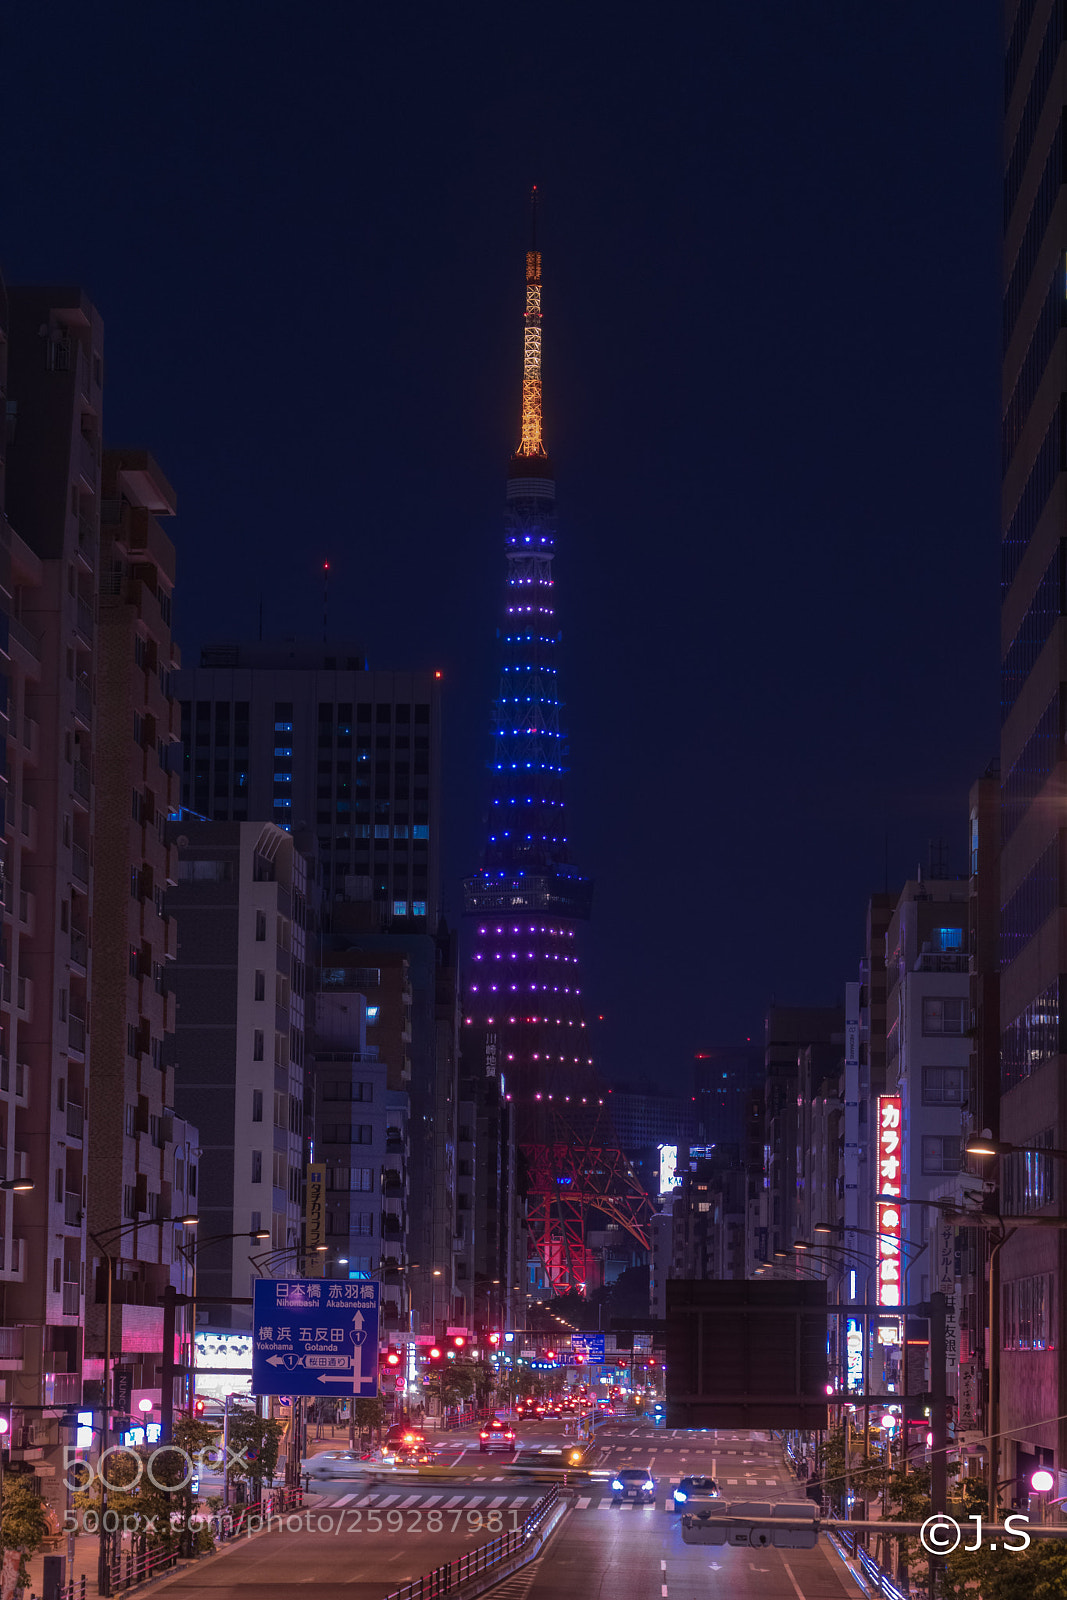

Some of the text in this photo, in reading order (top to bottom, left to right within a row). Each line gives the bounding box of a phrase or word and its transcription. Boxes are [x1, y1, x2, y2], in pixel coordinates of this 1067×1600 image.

[276, 1283, 375, 1299] 日本橋 赤羽橋
[276, 1299, 376, 1309] Nihonbashi Akabanebashi
[258, 1326, 344, 1342] 横浜 五反田
[256, 1342, 338, 1352] Yokohama Gotanda
[309, 1357, 346, 1366] 桜田通り
